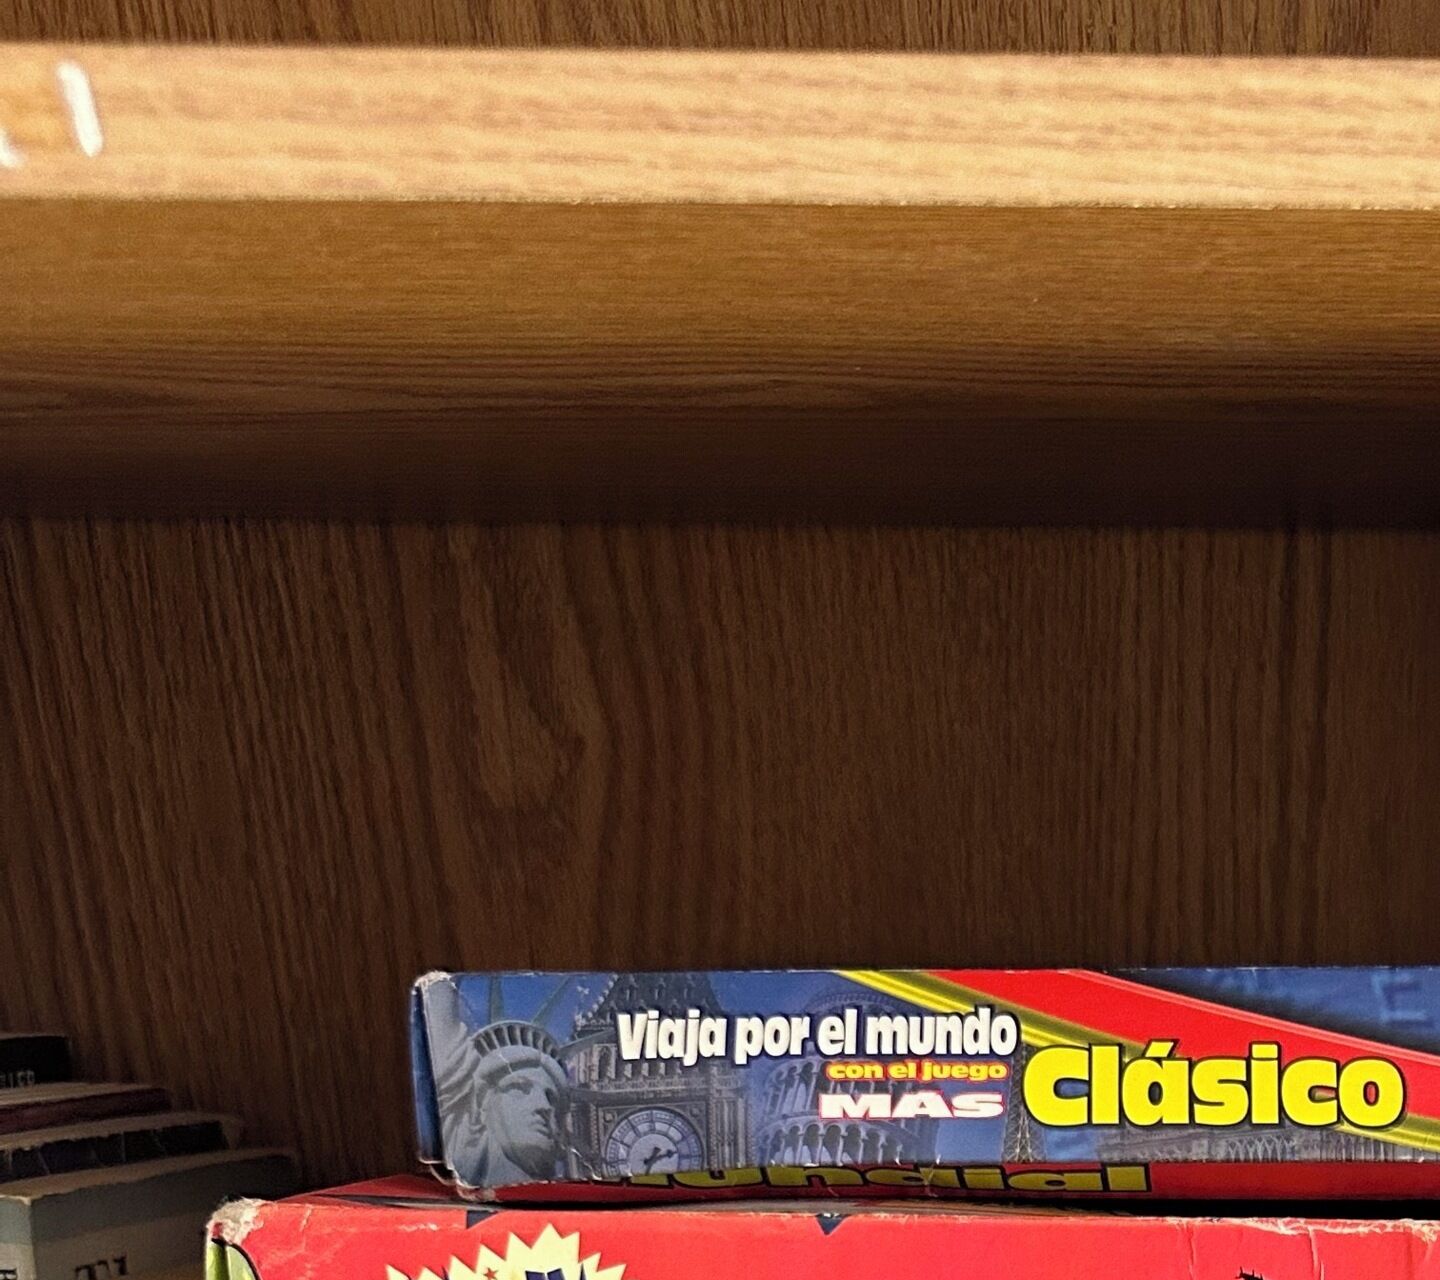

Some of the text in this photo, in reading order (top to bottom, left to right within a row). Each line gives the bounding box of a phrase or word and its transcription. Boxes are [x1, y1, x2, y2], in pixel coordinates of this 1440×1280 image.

[617, 1006, 1018, 1066] Viaja por el mundo
[826, 1060, 1009, 1082] con el juego
[1021, 1040, 1406, 1129] Clásico
[819, 1092, 1004, 1119] MAS
[598, 1163, 1150, 1192] undial
